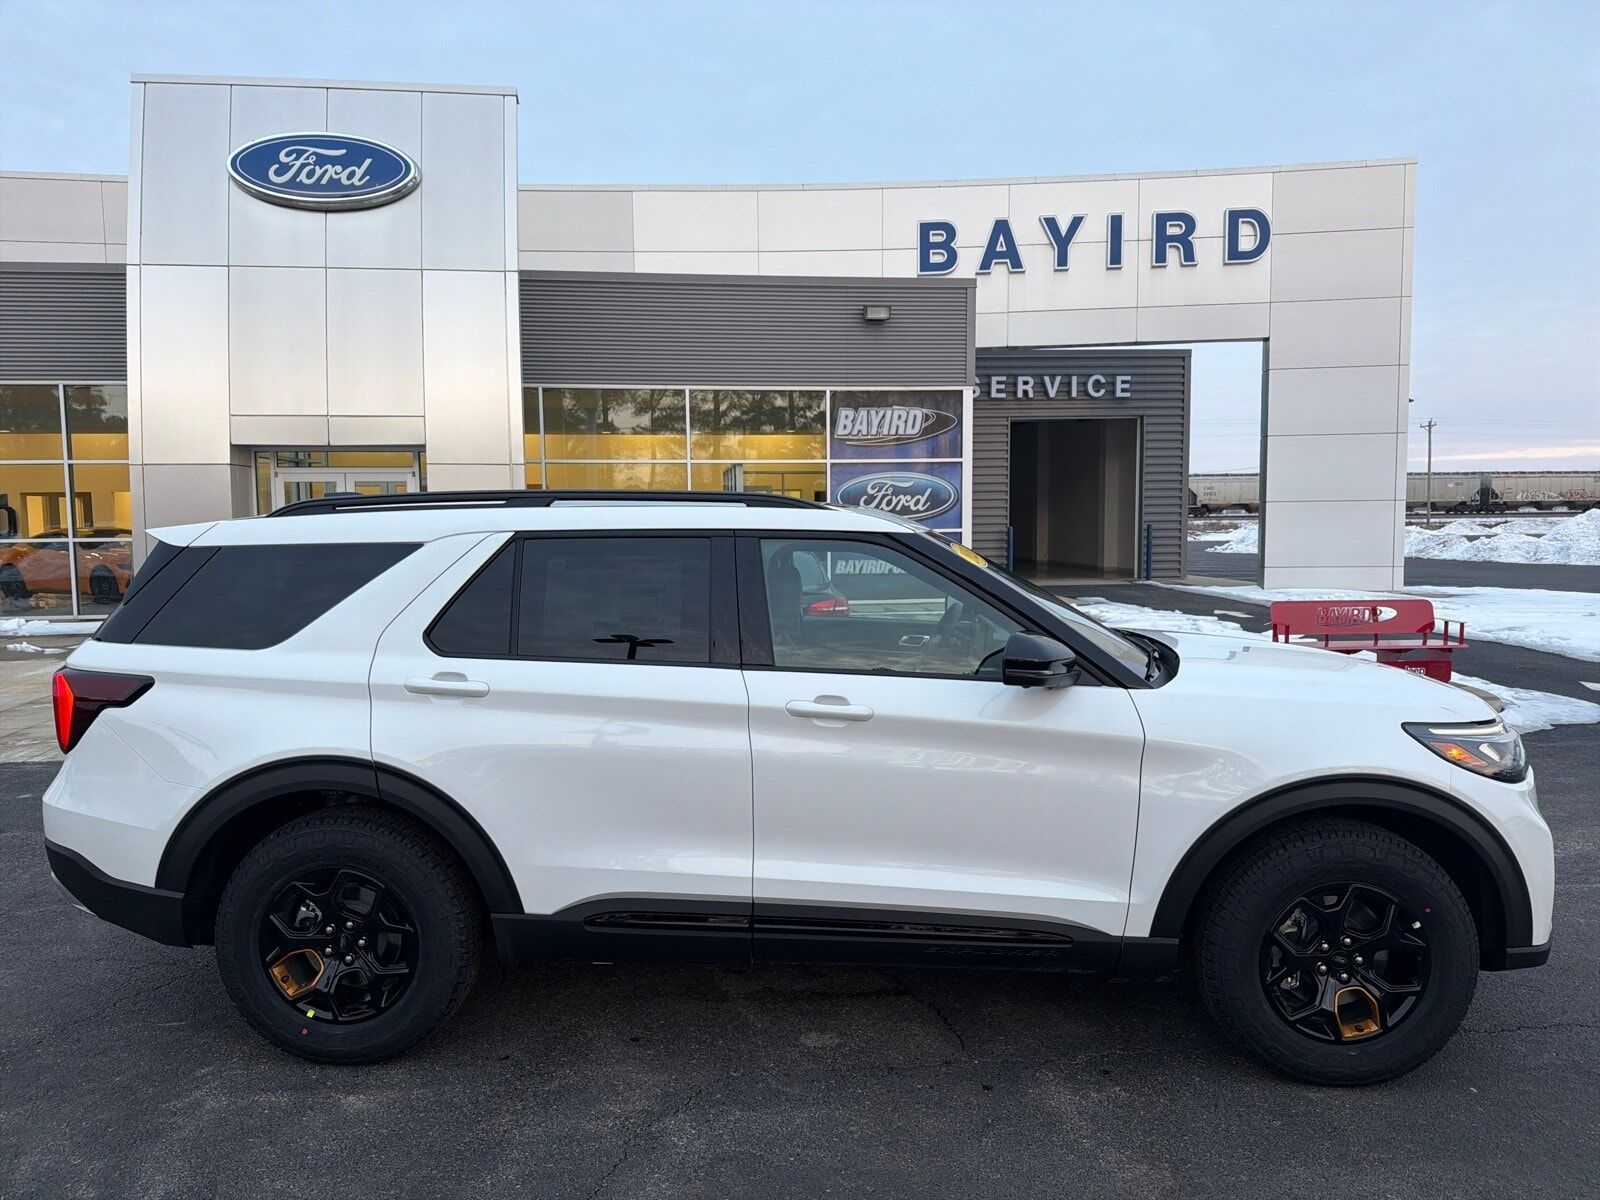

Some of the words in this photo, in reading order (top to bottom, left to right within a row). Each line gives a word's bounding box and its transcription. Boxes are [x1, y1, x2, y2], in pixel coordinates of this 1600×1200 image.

[269, 146, 372, 187] Ford
[916, 207, 1272, 276] BAYIRD
[835, 407, 925, 439] BAYIRD
[860, 479, 931, 512] Ford
